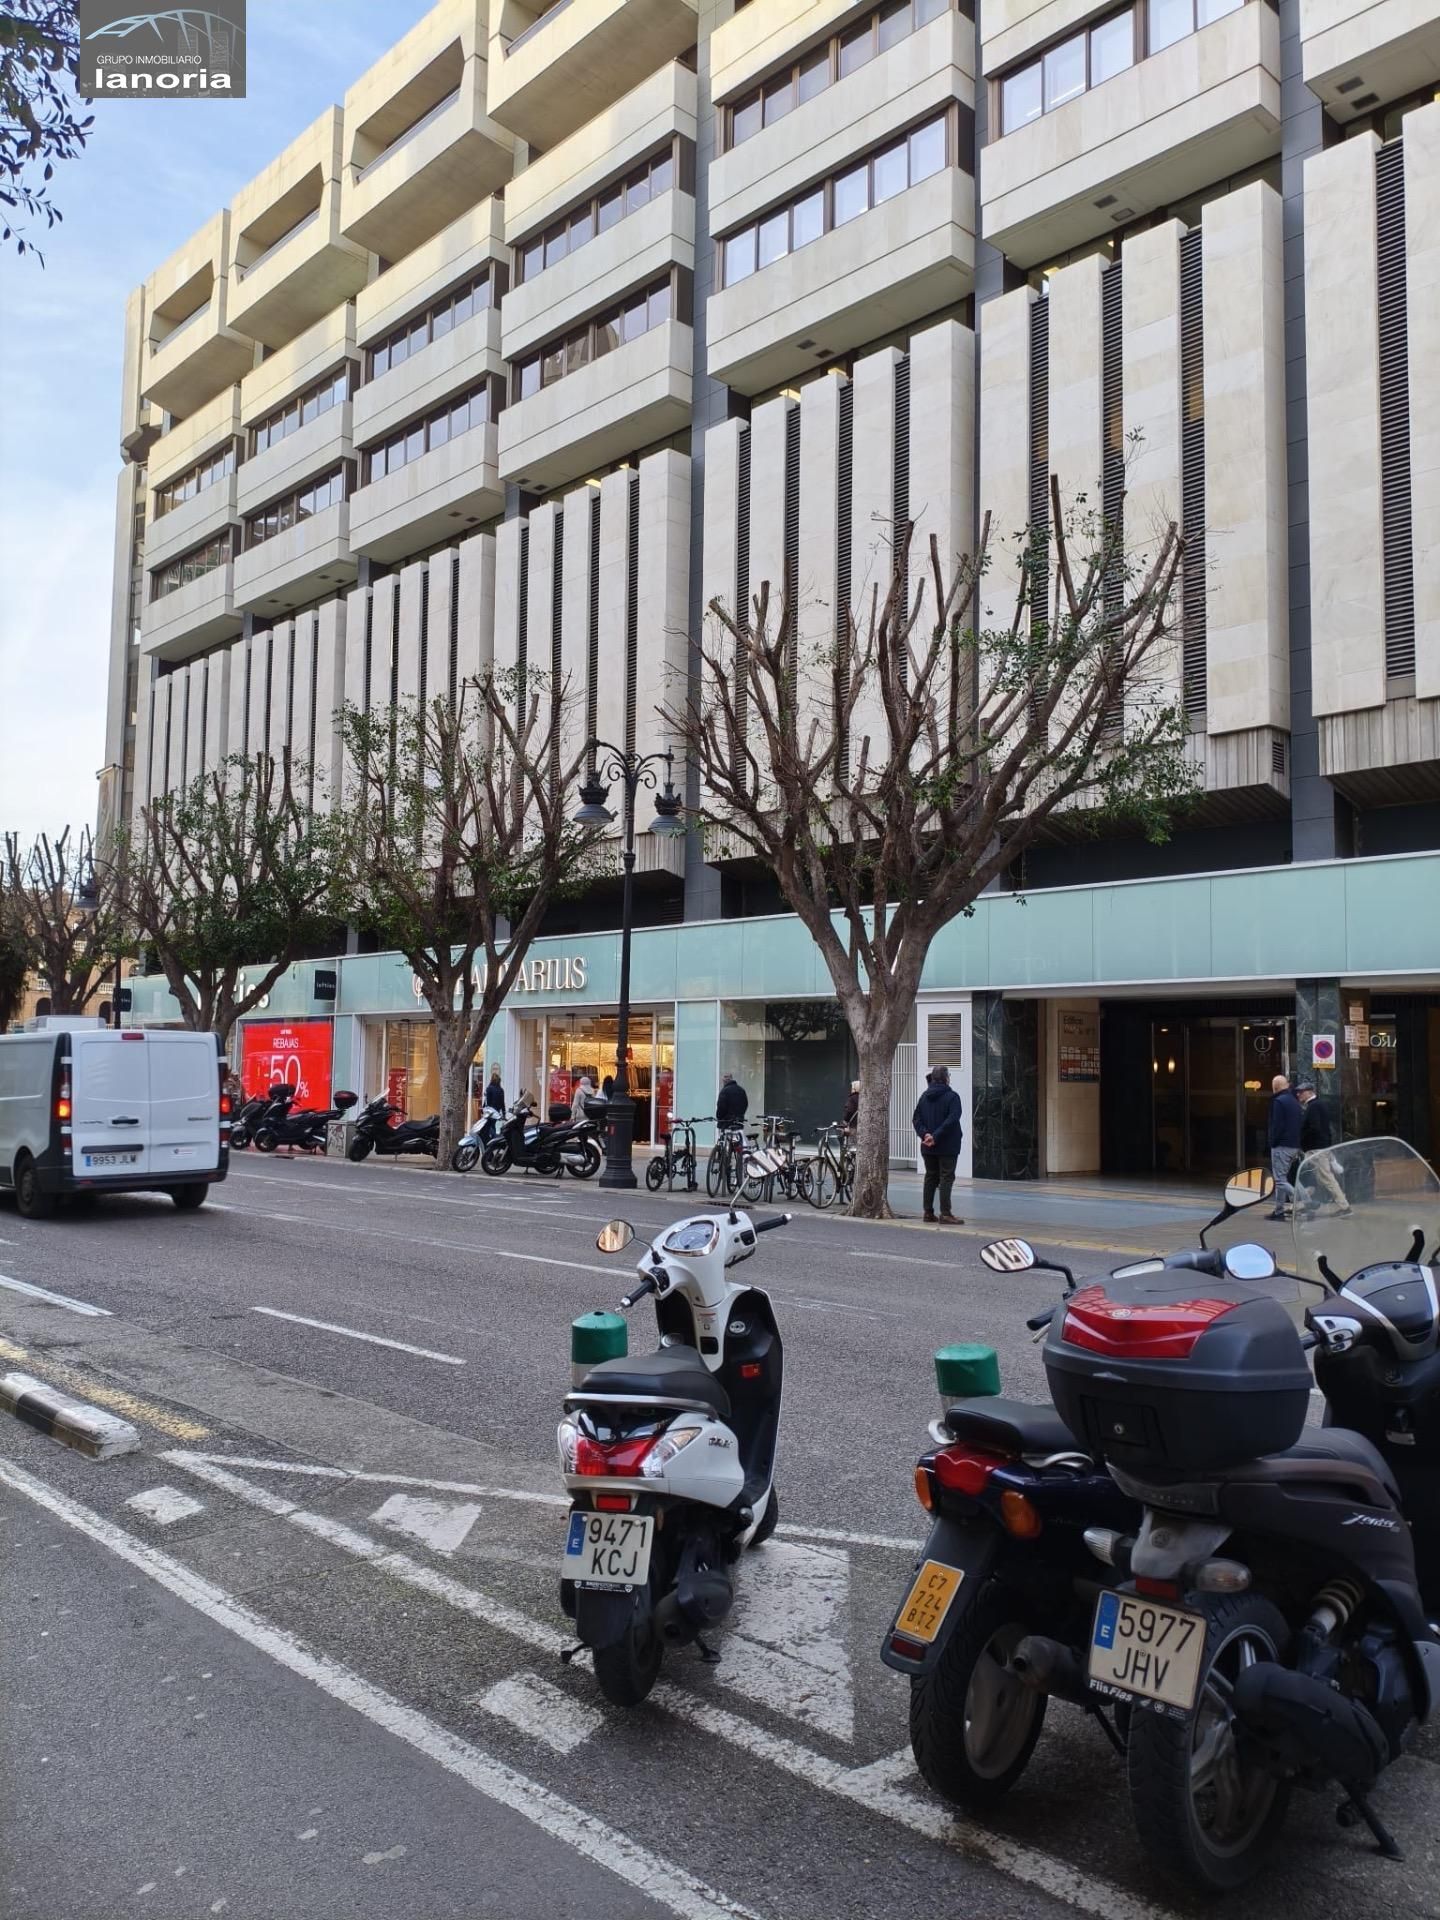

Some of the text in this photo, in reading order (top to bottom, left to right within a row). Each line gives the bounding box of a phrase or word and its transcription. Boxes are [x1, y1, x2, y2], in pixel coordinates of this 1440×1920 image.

[272, 1037, 299, 1049] REBAJAS
[92, 1155, 116, 1166] 9953
[588, 1518, 648, 1549] 9471
[571, 1538, 580, 1549] E
[590, 1547, 638, 1578] KCJ
[928, 1574, 948, 1590] C7
[1100, 1624, 1111, 1639] E
[1118, 1602, 1197, 1653] 5977
[1112, 1647, 1171, 1692] JHV
